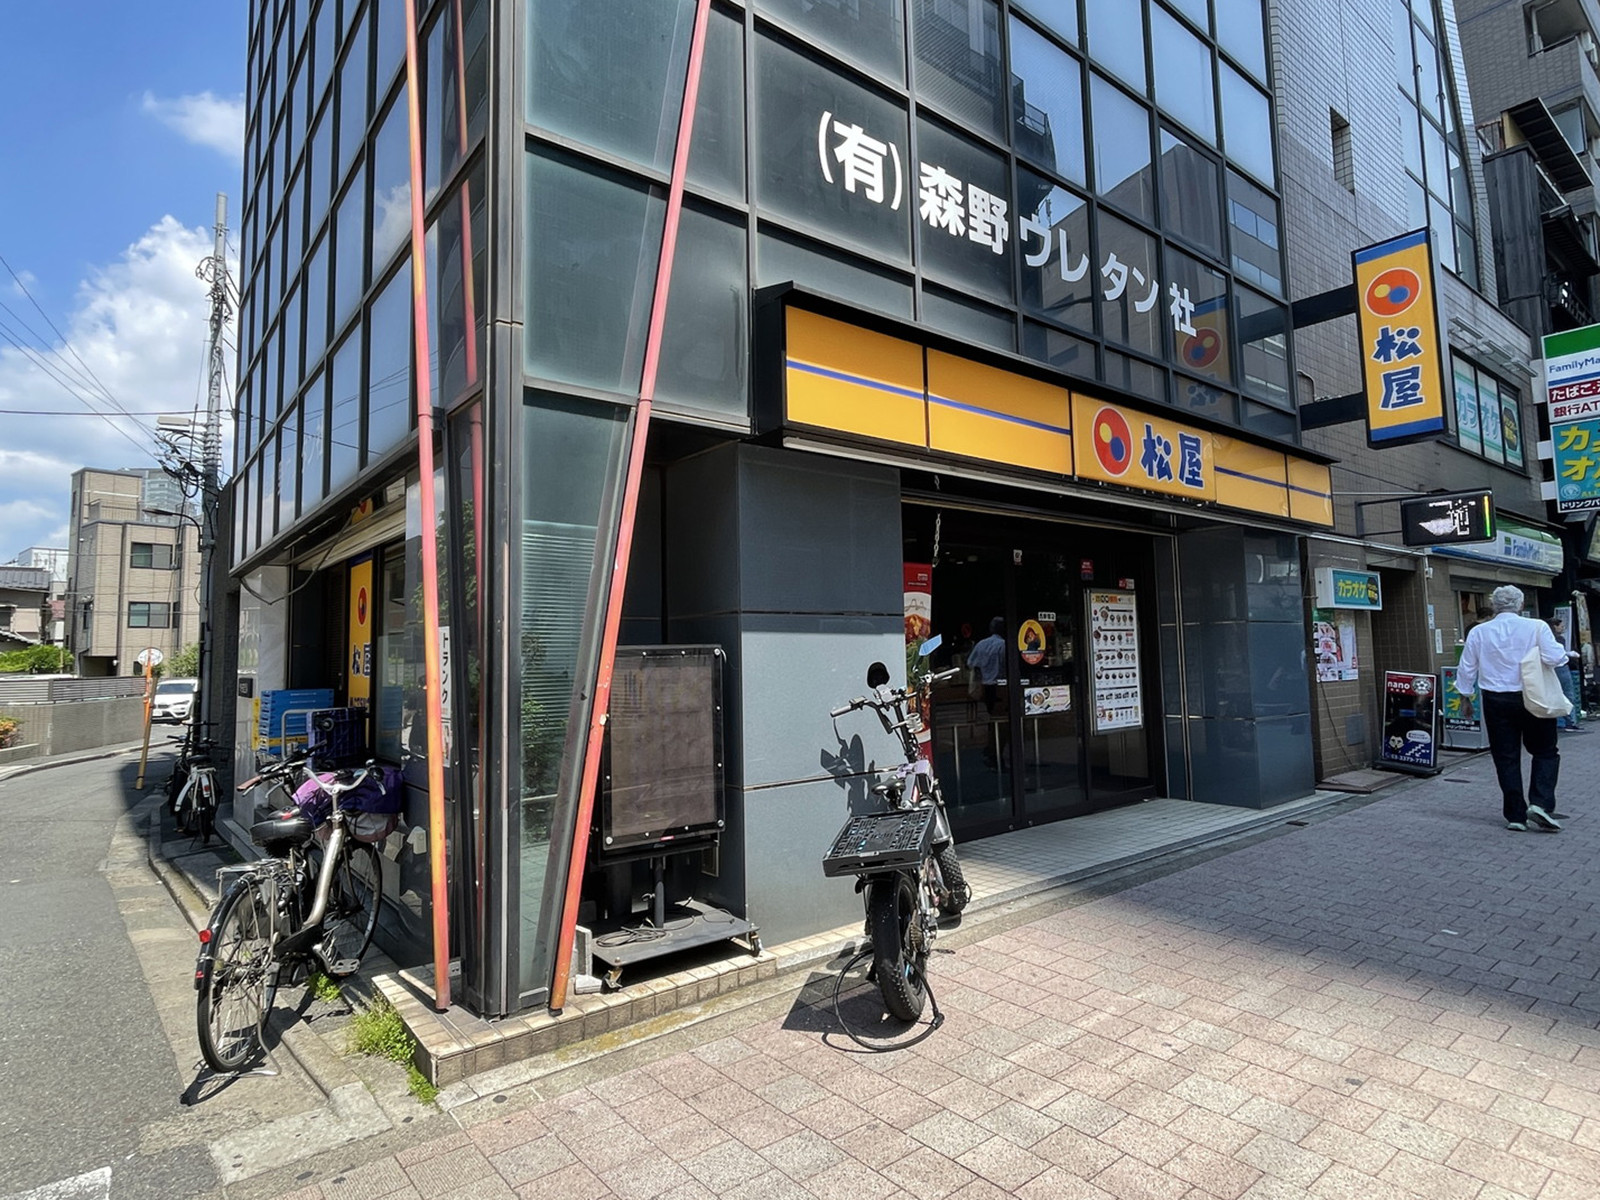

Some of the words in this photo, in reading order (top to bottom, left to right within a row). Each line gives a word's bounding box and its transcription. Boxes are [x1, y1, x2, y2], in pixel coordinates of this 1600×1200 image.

[1371, 325, 1426, 411] 松屋
[1140, 422, 1205, 489] 松屋
[1562, 456, 1600, 487] オ
[1338, 580, 1367, 599] カラオケ
[1388, 681, 1410, 690] nano
